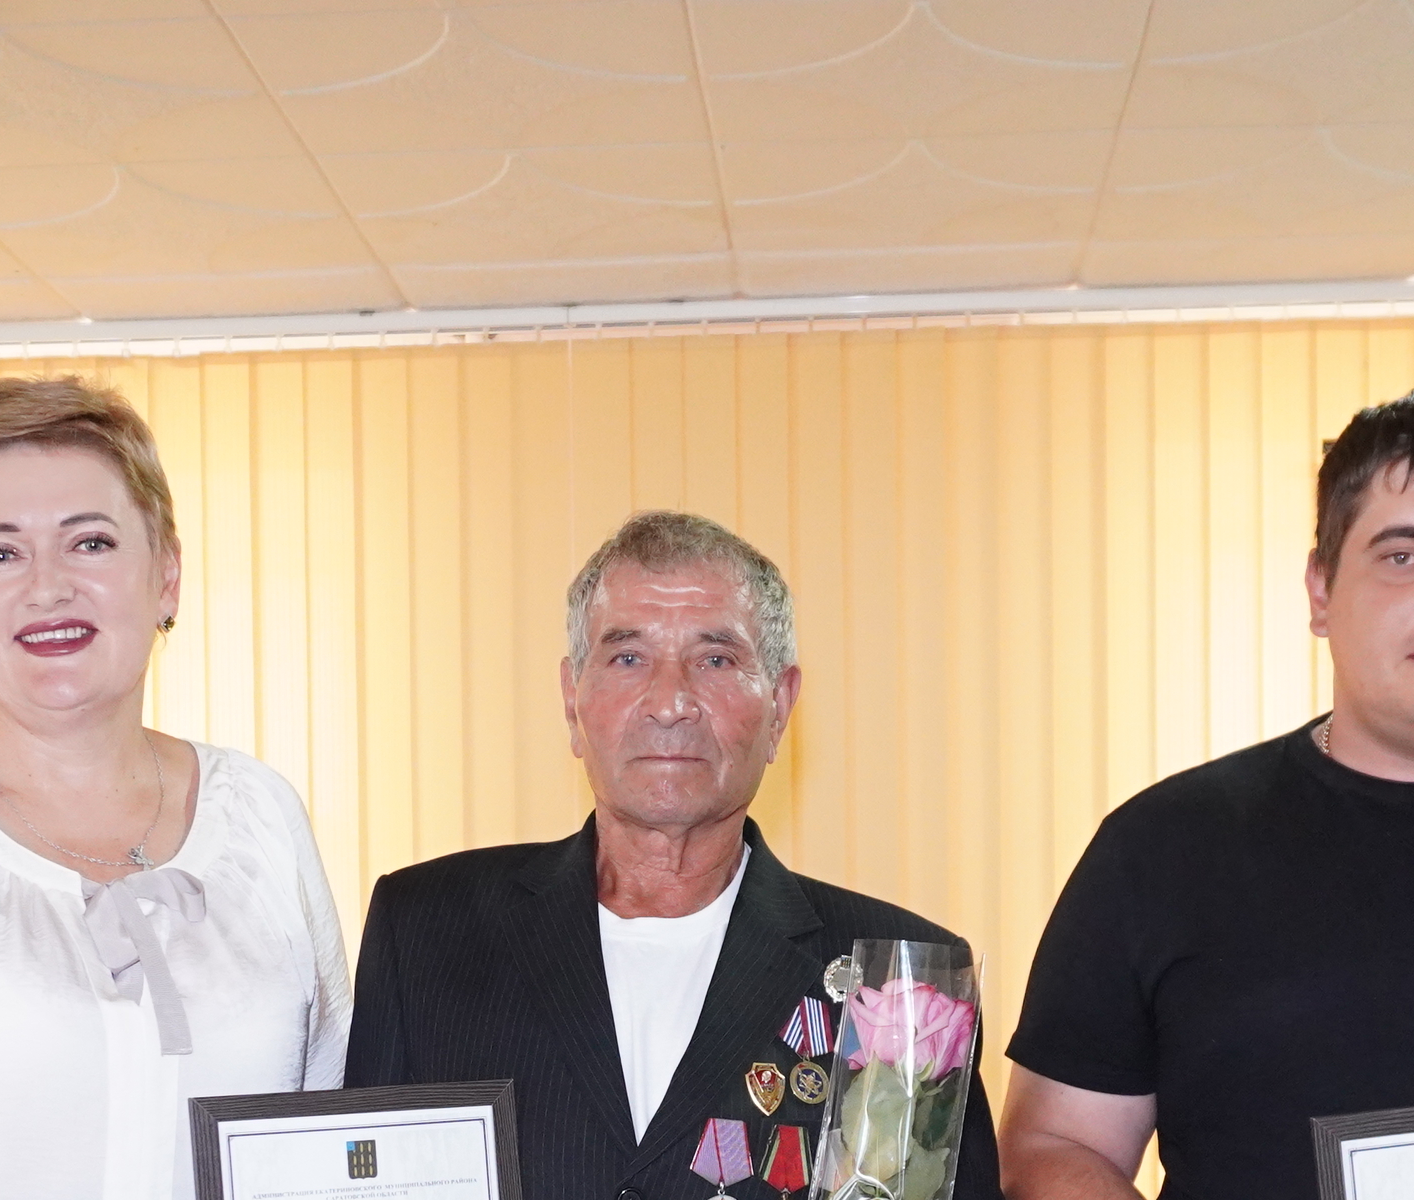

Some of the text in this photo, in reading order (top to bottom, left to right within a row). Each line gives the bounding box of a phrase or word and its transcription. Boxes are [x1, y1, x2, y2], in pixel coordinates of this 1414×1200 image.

[252, 1177, 477, 1200] АДМИНИСТРАЦИЯ ЕКАТЕРИНОВСКОГО МУНИЦИПАЛЬНОГО РАЙОНА
